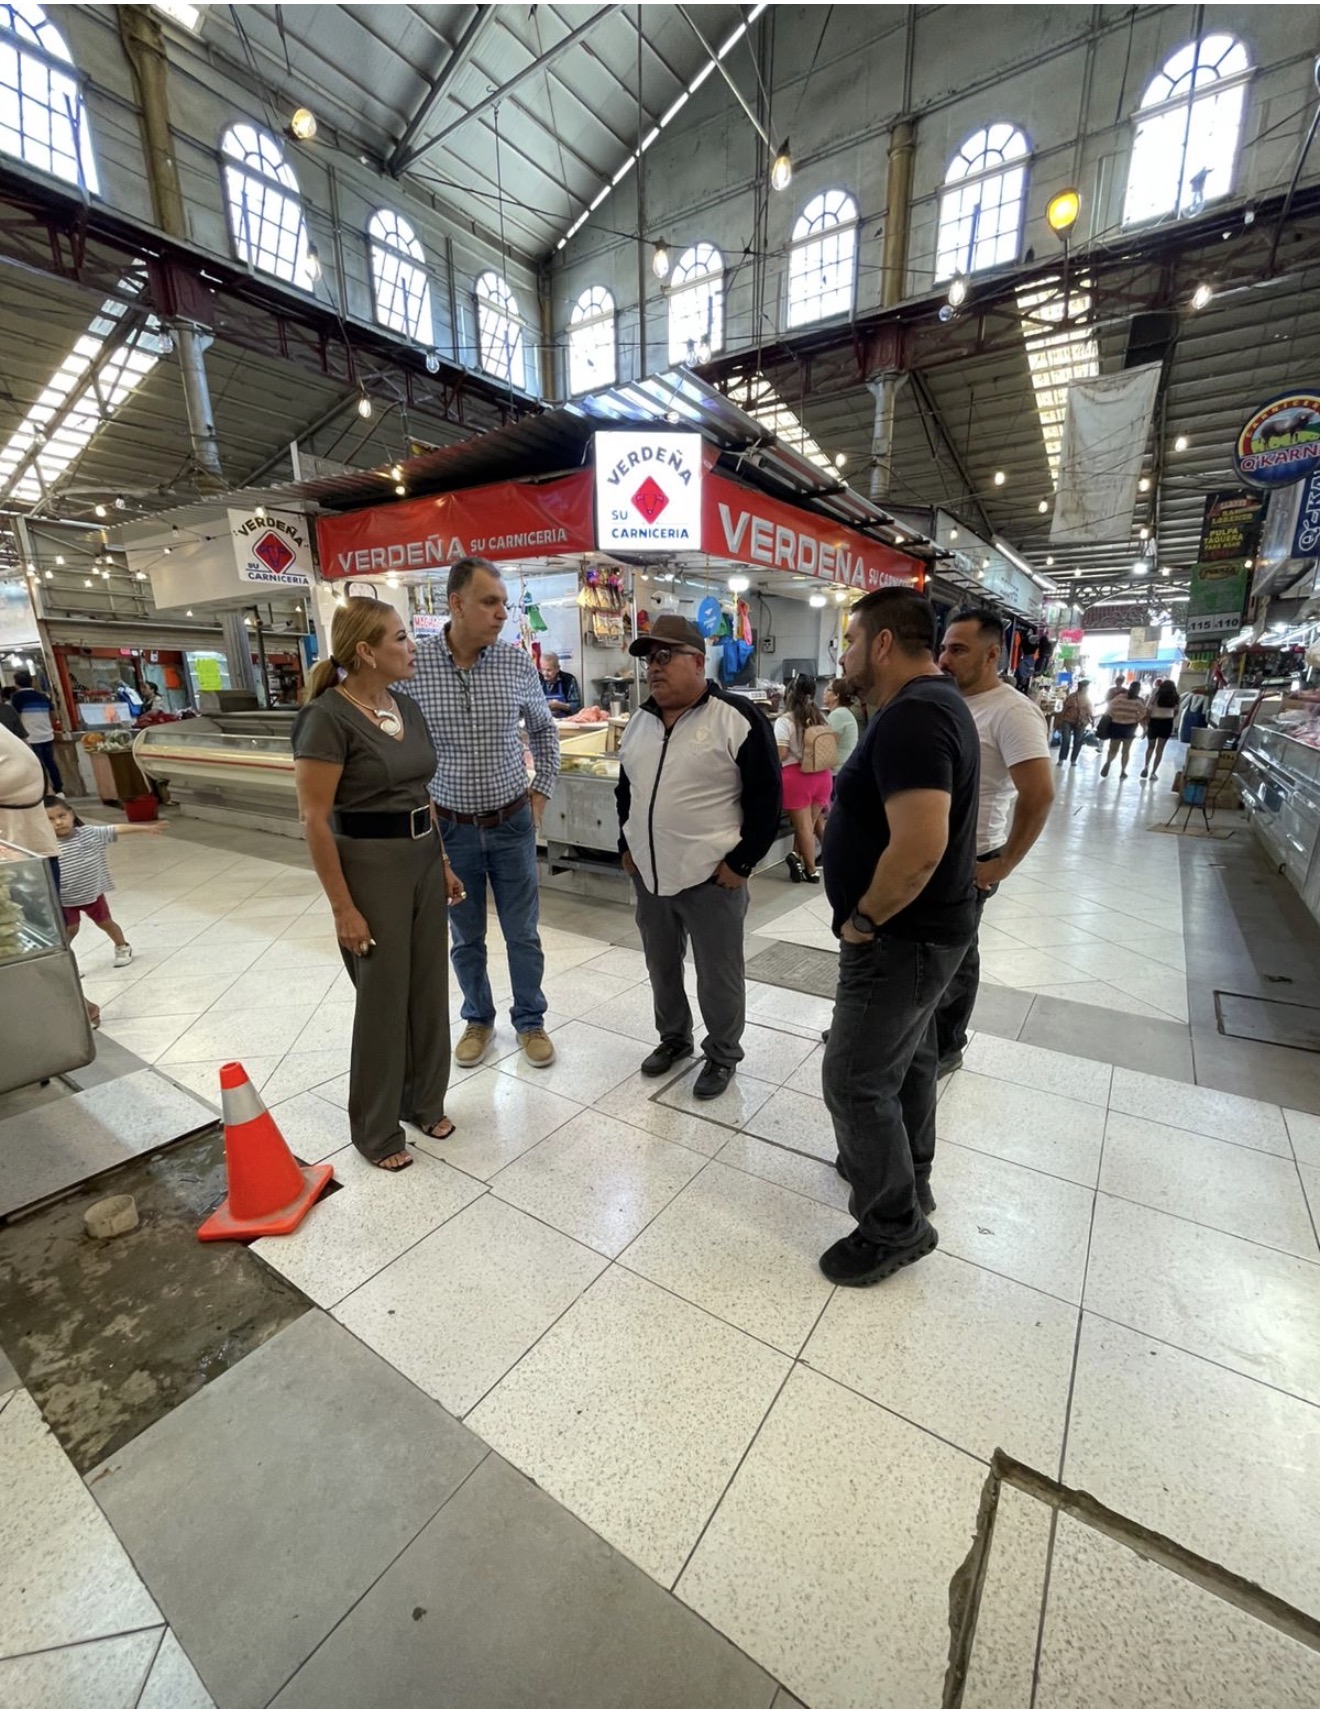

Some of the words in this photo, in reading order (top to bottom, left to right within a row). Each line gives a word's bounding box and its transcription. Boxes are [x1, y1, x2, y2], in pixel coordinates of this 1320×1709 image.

[606, 446, 693, 487] VERDEÑA
[610, 509, 628, 521] SU
[611, 527, 690, 539] CARNICERIA
[718, 502, 866, 587] VERDEÑA
[868, 567, 879, 586] SU
[337, 533, 467, 573] VERDEÑA
[470, 538, 486, 553] SU
[488, 528, 568, 552] CARNICERIA
[248, 572, 309, 585] CARNICERIA
